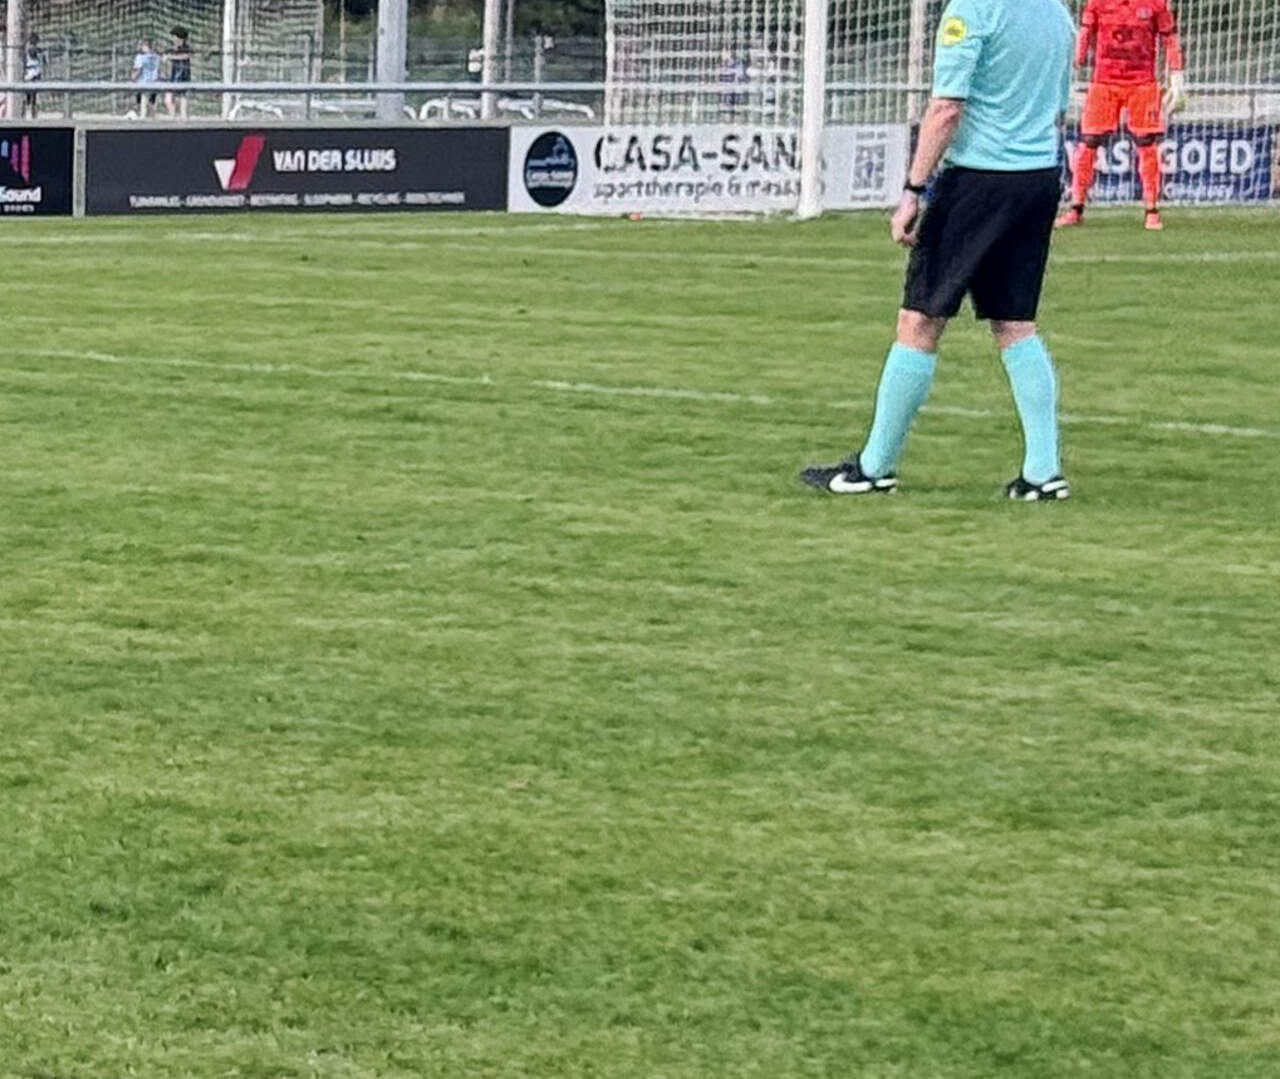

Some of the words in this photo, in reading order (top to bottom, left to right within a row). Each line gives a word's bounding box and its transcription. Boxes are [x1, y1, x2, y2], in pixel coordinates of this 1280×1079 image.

[273, 150, 305, 172] VAN
[307, 149, 342, 171] DER
[344, 148, 397, 171] SLUIS
[593, 133, 828, 172] CASA-SAN
